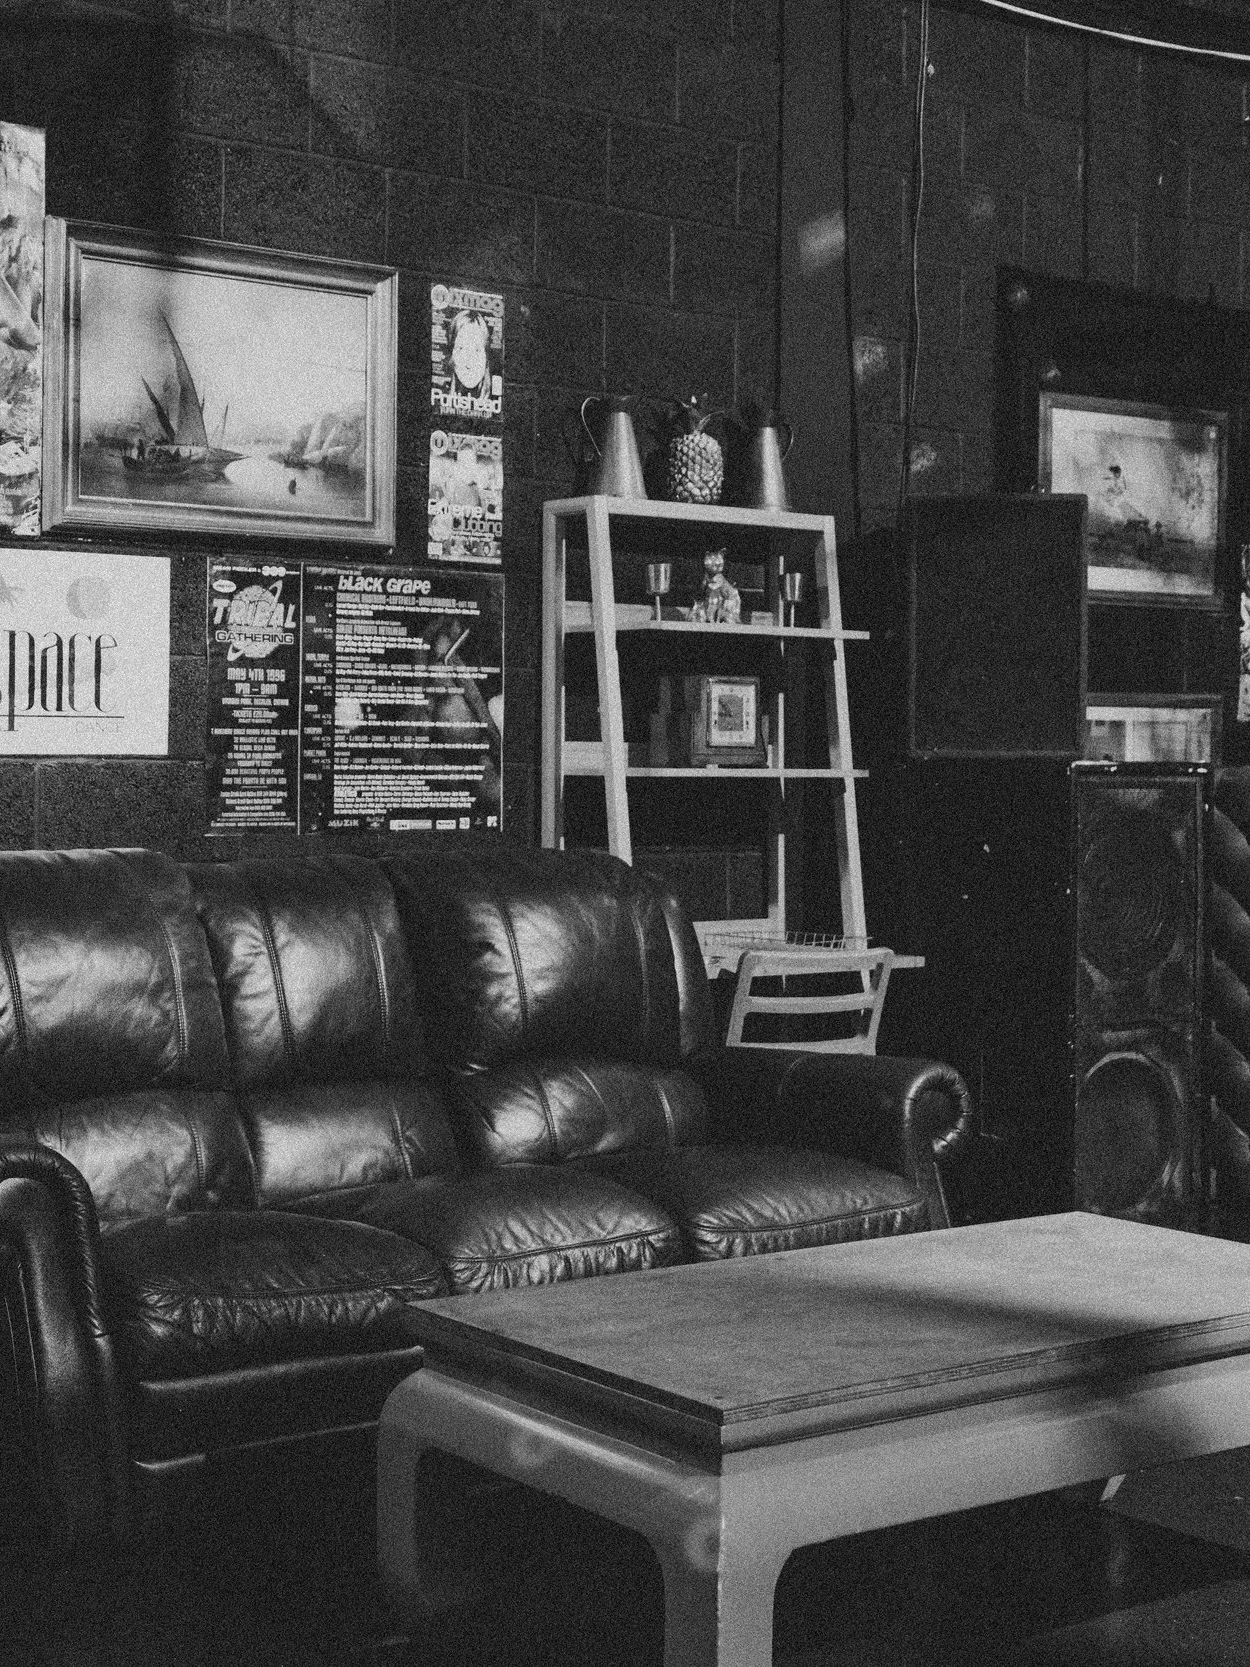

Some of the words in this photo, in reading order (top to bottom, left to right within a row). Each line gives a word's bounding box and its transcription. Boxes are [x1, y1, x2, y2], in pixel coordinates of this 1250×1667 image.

[431, 388, 502, 414] Portishead
[212, 598, 296, 628] TRIBAL
[215, 630, 294, 645] GATHERING
[227, 667, 246, 681] MAY
[248, 668, 264, 681] 4TH
